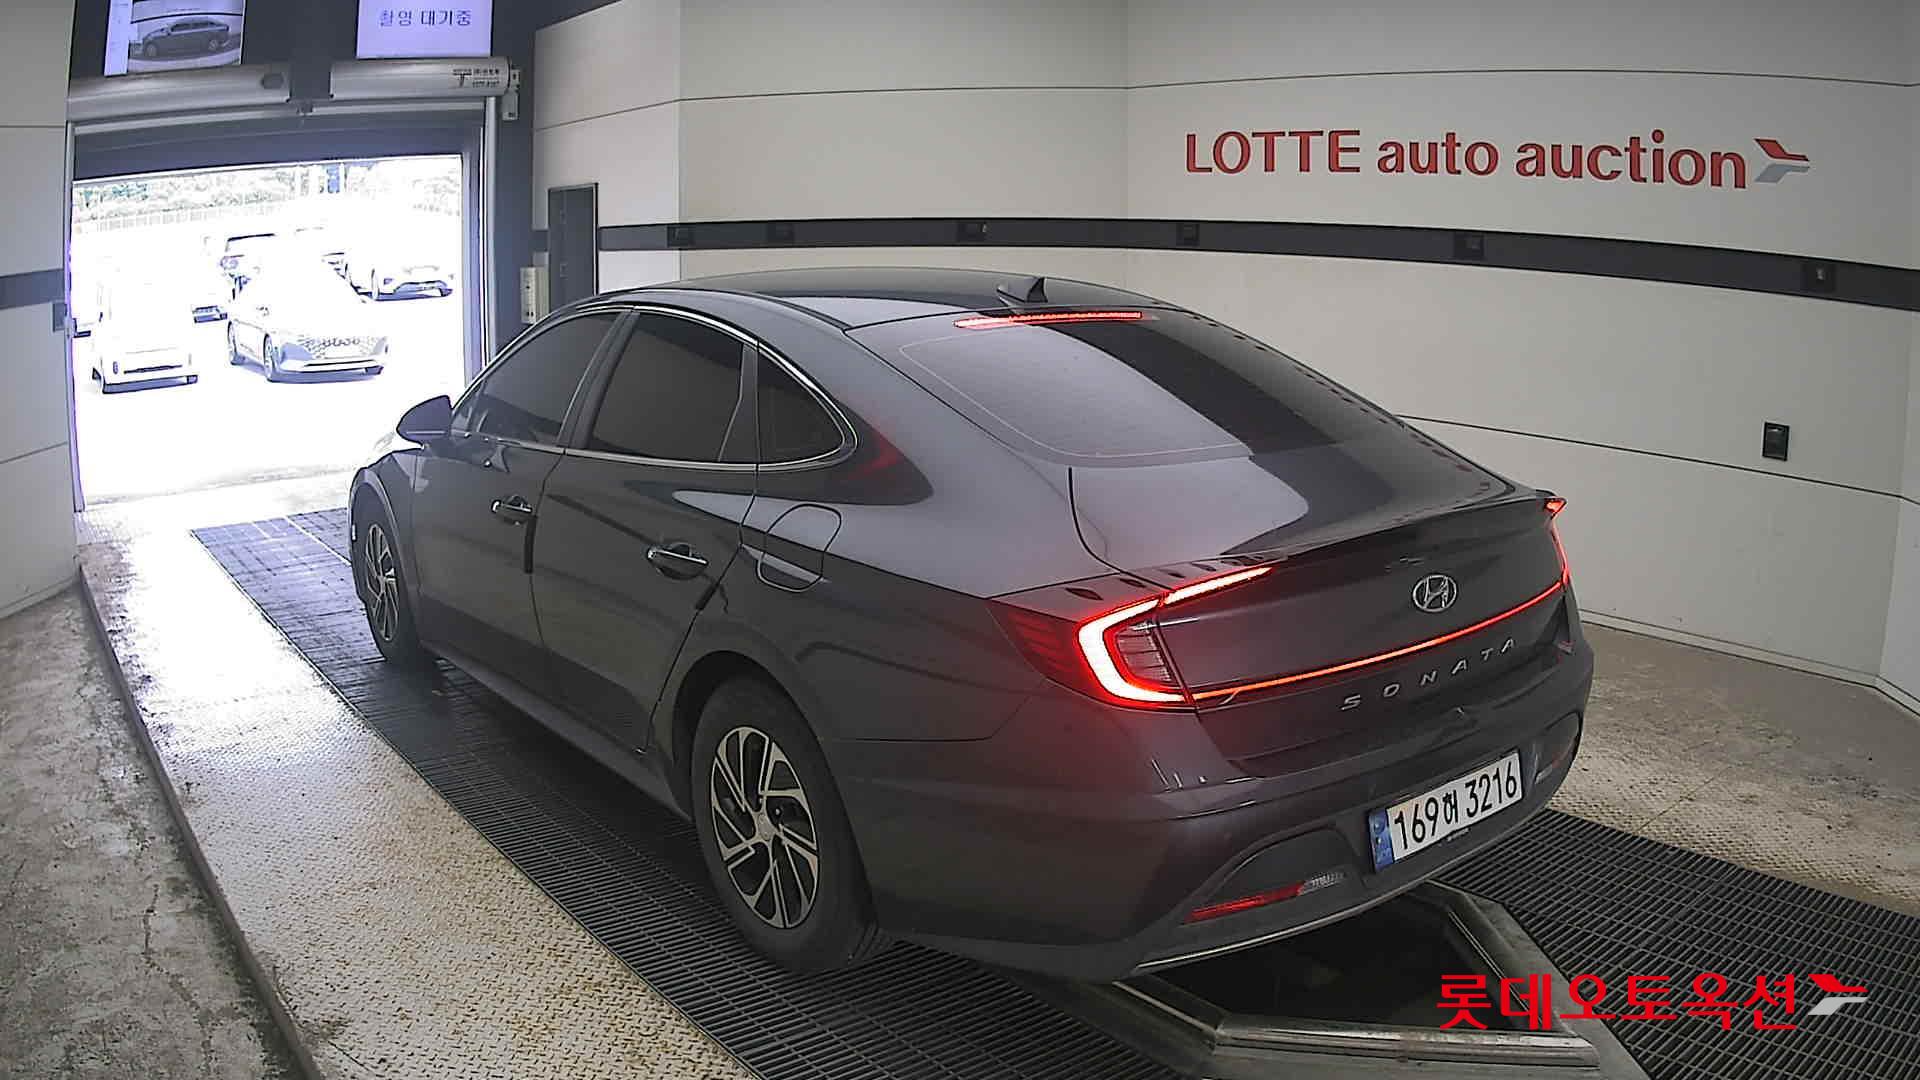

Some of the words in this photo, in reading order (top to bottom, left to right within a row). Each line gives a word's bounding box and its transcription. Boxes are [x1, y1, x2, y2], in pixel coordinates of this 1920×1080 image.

[421, 9, 472, 27] 대기중
[1186, 130, 1361, 174] LOTTE
[1378, 132, 1500, 176] auto
[1515, 129, 1747, 188] auction
[1341, 637, 1515, 711] SONATA
[1464, 760, 1518, 818] 3216
